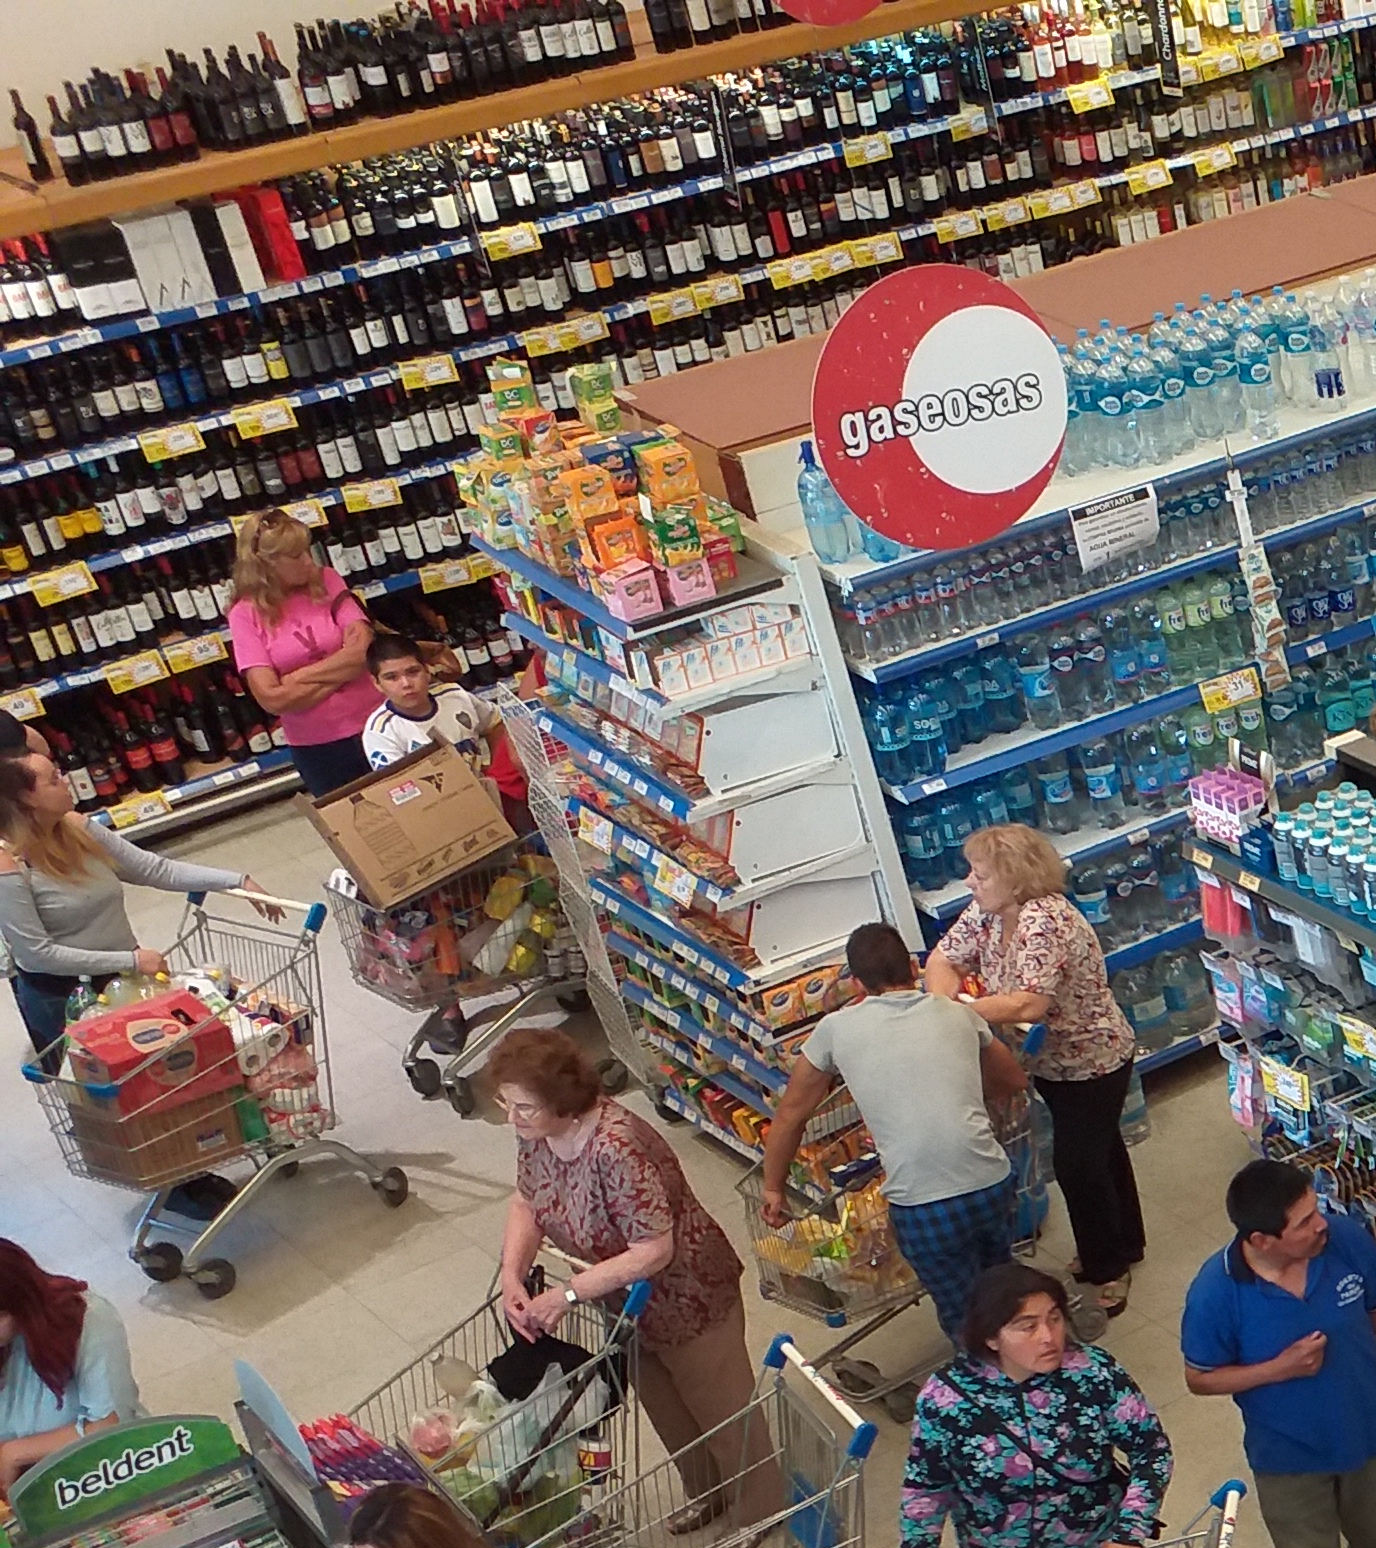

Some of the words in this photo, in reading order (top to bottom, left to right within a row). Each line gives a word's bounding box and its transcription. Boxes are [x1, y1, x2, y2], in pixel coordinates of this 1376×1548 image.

[1162, 0, 1173, 60] Chardonn
[840, 370, 1043, 458] gaseosas
[1084, 492, 1136, 517] IMPORTANTE
[55, 1425, 194, 1510] beldent
